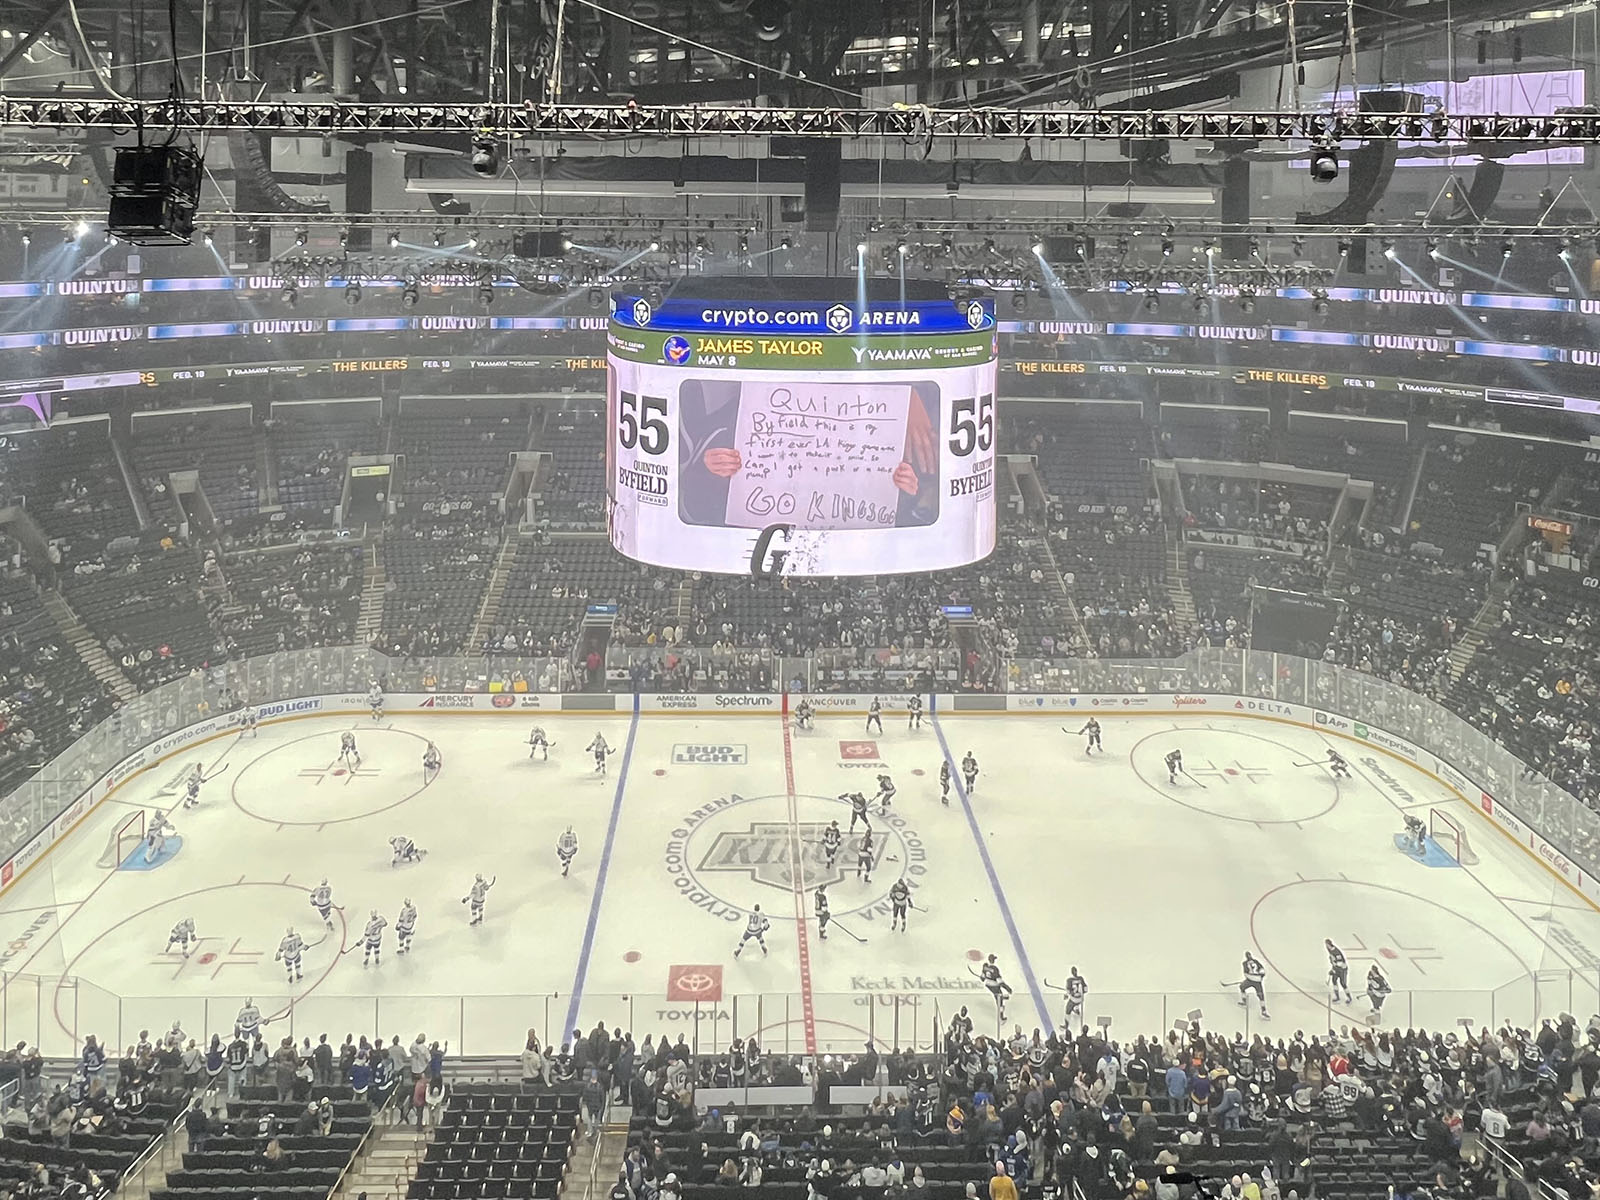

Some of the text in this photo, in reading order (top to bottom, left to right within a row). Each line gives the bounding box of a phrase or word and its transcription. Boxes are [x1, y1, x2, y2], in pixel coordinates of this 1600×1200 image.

[702, 308, 920, 326] crypto.com ARENA
[697, 339, 823, 355] JAMES TAYLOR
[332, 361, 358, 372] THE
[360, 360, 408, 371] KILLERS
[565, 359, 608, 369] THE KIL
[698, 356, 736, 366] MAY 8
[1015, 362, 1038, 373] THE
[1041, 363, 1085, 373] KILLERS
[1248, 370, 1274, 381] THE
[1276, 372, 1327, 385] KILLERS
[770, 388, 887, 417] Quinton
[619, 390, 669, 456] 55
[948, 393, 993, 457] 55
[633, 460, 668, 476] QUINTON
[619, 466, 668, 495] BYFIELD
[746, 486, 796, 517] GO
[258, 699, 320, 720] BUD LIGHT
[715, 695, 769, 708] Spectrum
[1248, 701, 1292, 715] DELTA
[163, 722, 217, 750] crypto.com
[676, 754, 742, 763] LIGHT
[684, 793, 744, 827] ARENA
[1493, 806, 1520, 833] TOYOTA
[15, 841, 42, 868] TOYOTA
[666, 840, 741, 922] crypto.com
[851, 976, 984, 990] Keck Medicine
[656, 1010, 730, 1021] TOYOTA
[1343, 1086, 1357, 1097] 99
[1493, 1122, 1500, 1133] 8
